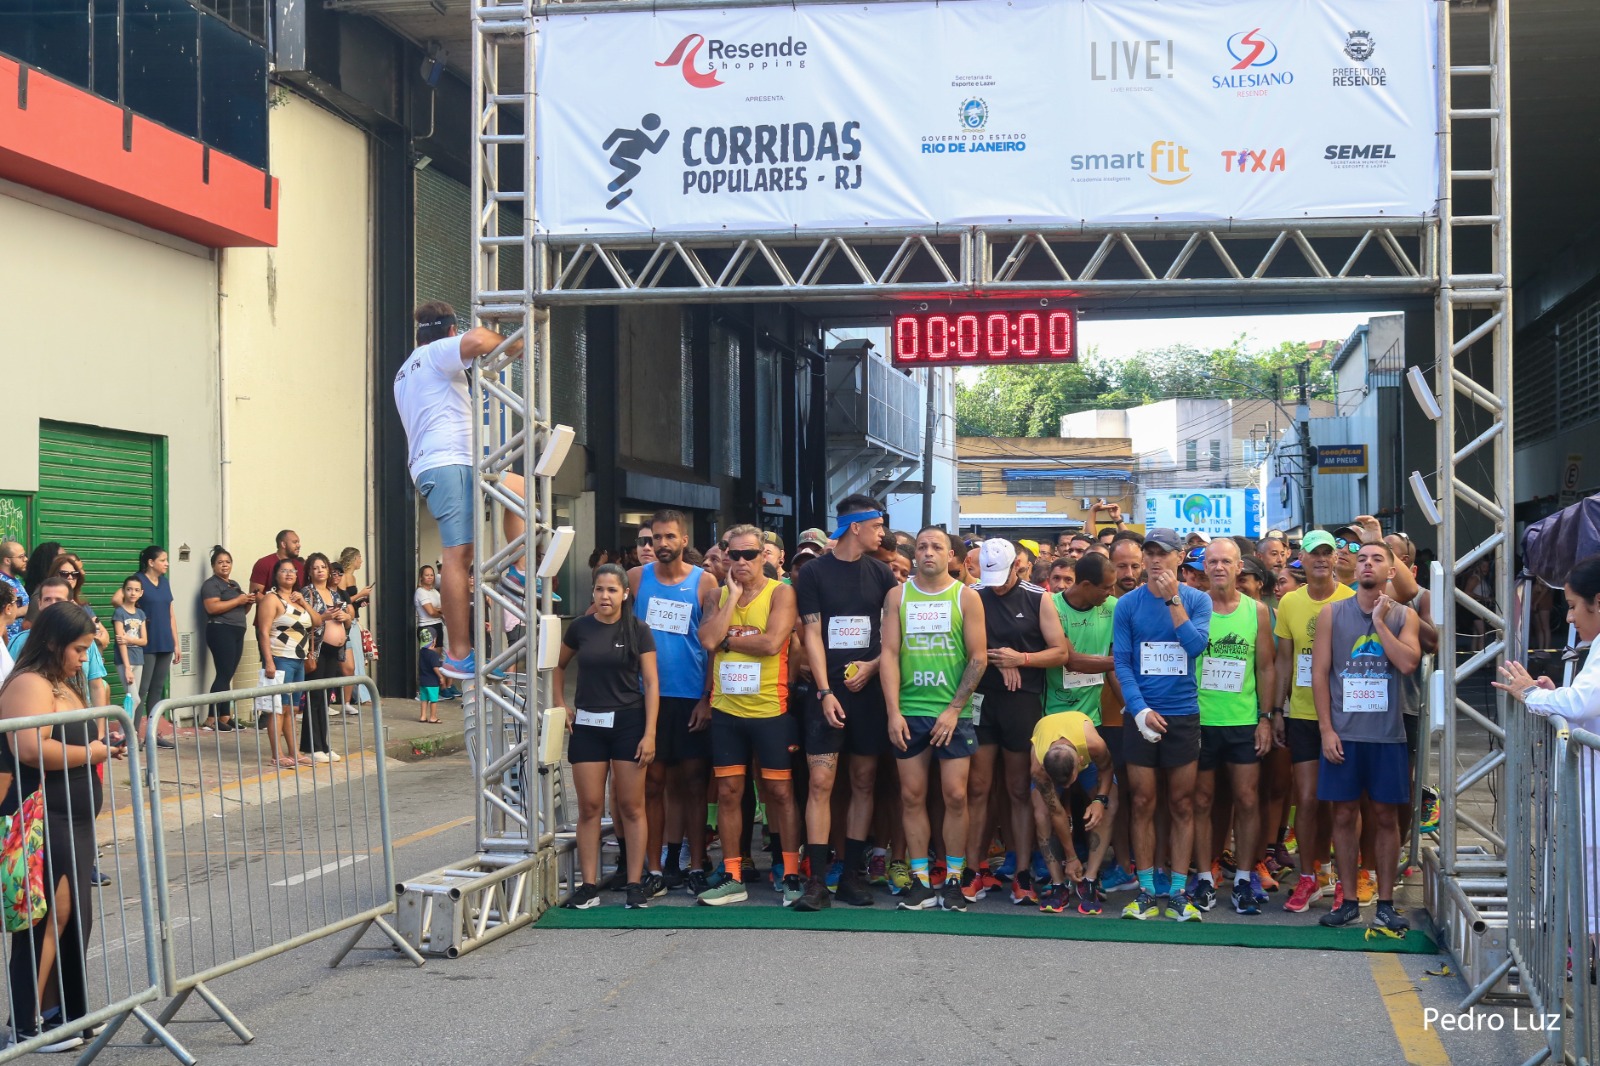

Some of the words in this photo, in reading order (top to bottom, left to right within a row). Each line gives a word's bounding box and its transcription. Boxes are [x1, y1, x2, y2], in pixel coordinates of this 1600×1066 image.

[708, 36, 807, 59] Resende
[708, 59, 805, 70] Shopping
[1091, 40, 1173, 80] LIVE!
[1332, 67, 1386, 76] PREFEITURA
[1212, 71, 1294, 88] SALESIANO
[1332, 76, 1387, 86] RESENDE
[1236, 89, 1268, 97] RESENDE
[682, 121, 862, 167] CORRIDAS
[921, 143, 946, 153] RIO
[948, 142, 966, 153] DE
[969, 141, 1026, 153] JANEIRO
[1070, 151, 1145, 170] smart
[1150, 140, 1190, 173] fit
[1323, 144, 1396, 160] SEMEL
[1221, 147, 1285, 173] TIXA
[683, 166, 808, 195] POPULARES
[835, 165, 862, 190] RJ
[898, 312, 1070, 359] 00:00:00
[1336, 456, 1358, 464] PNEUS
[658, 610, 678, 620] 1261
[917, 611, 939, 621] 5023
[839, 627, 861, 636] 5022
[1153, 653, 1175, 662] 1105
[728, 673, 748, 682] 5289
[913, 670, 948, 687] BRA
[1212, 670, 1232, 678] 1177
[1352, 690, 1376, 699] 5383
